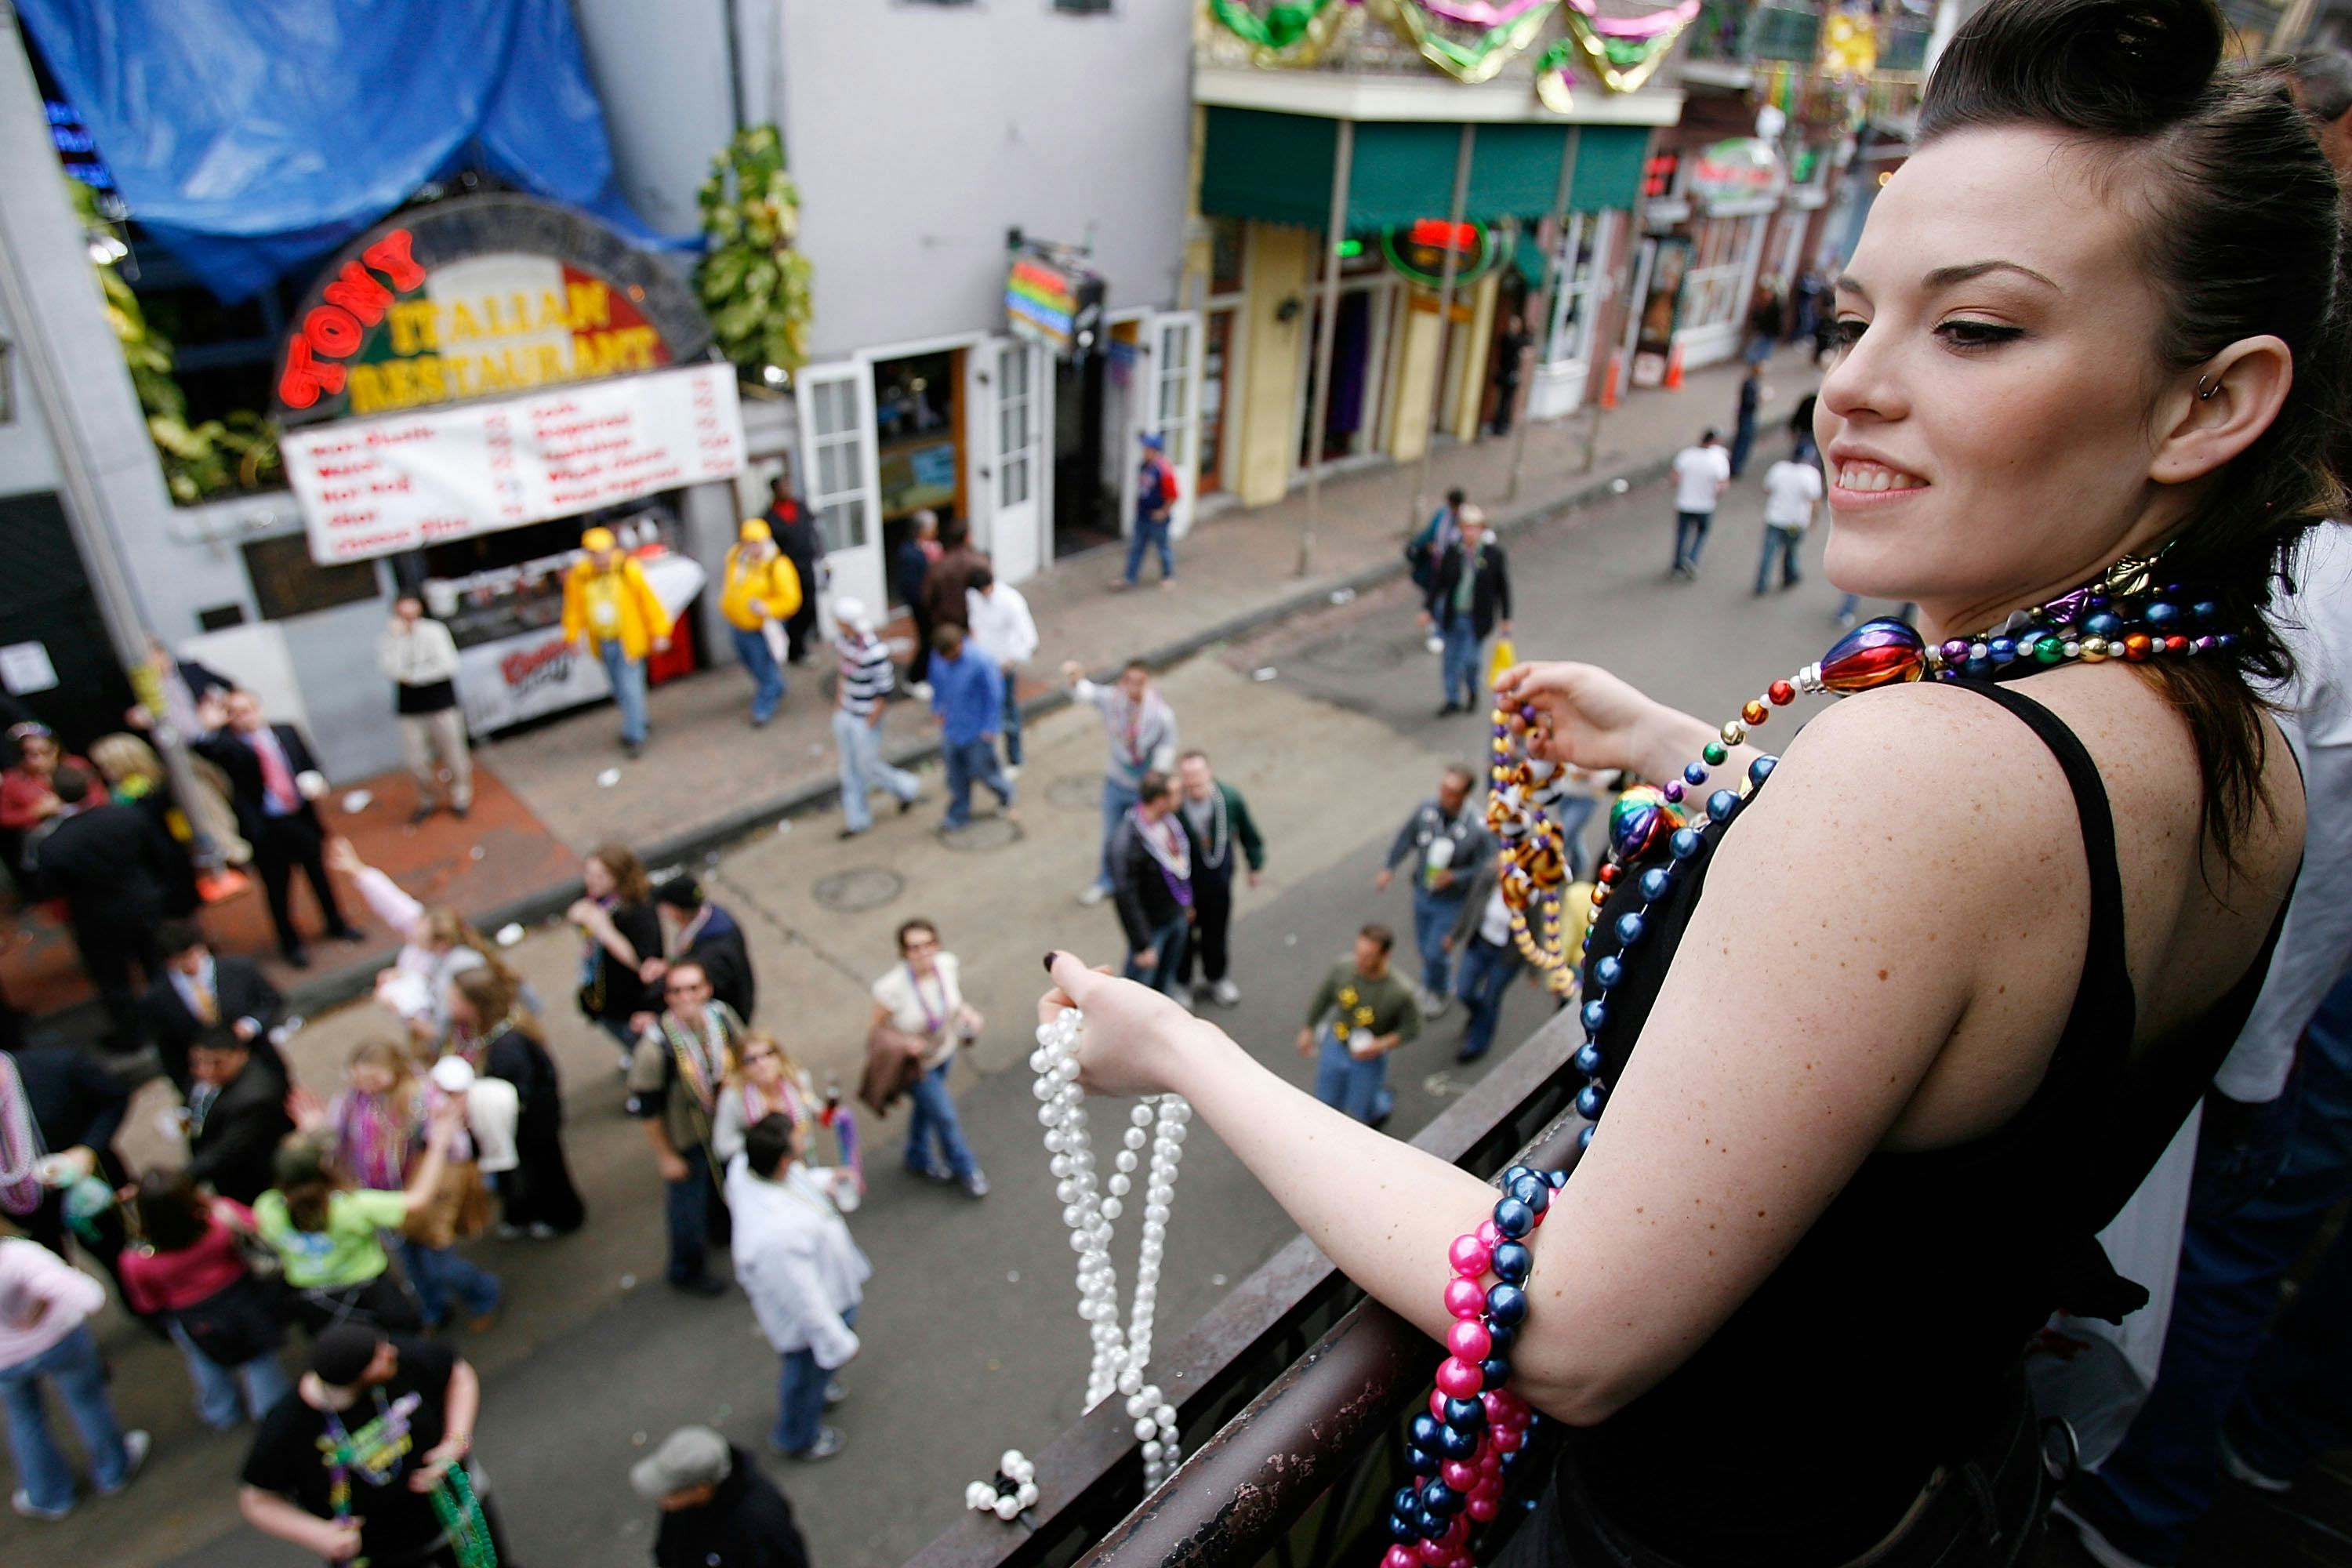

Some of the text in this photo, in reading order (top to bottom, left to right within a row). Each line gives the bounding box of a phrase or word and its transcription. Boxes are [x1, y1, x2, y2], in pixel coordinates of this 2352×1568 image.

[278, 228, 426, 408] TONY
[387, 279, 611, 353] ITALIAN
[348, 325, 660, 417] RESTAURANT
